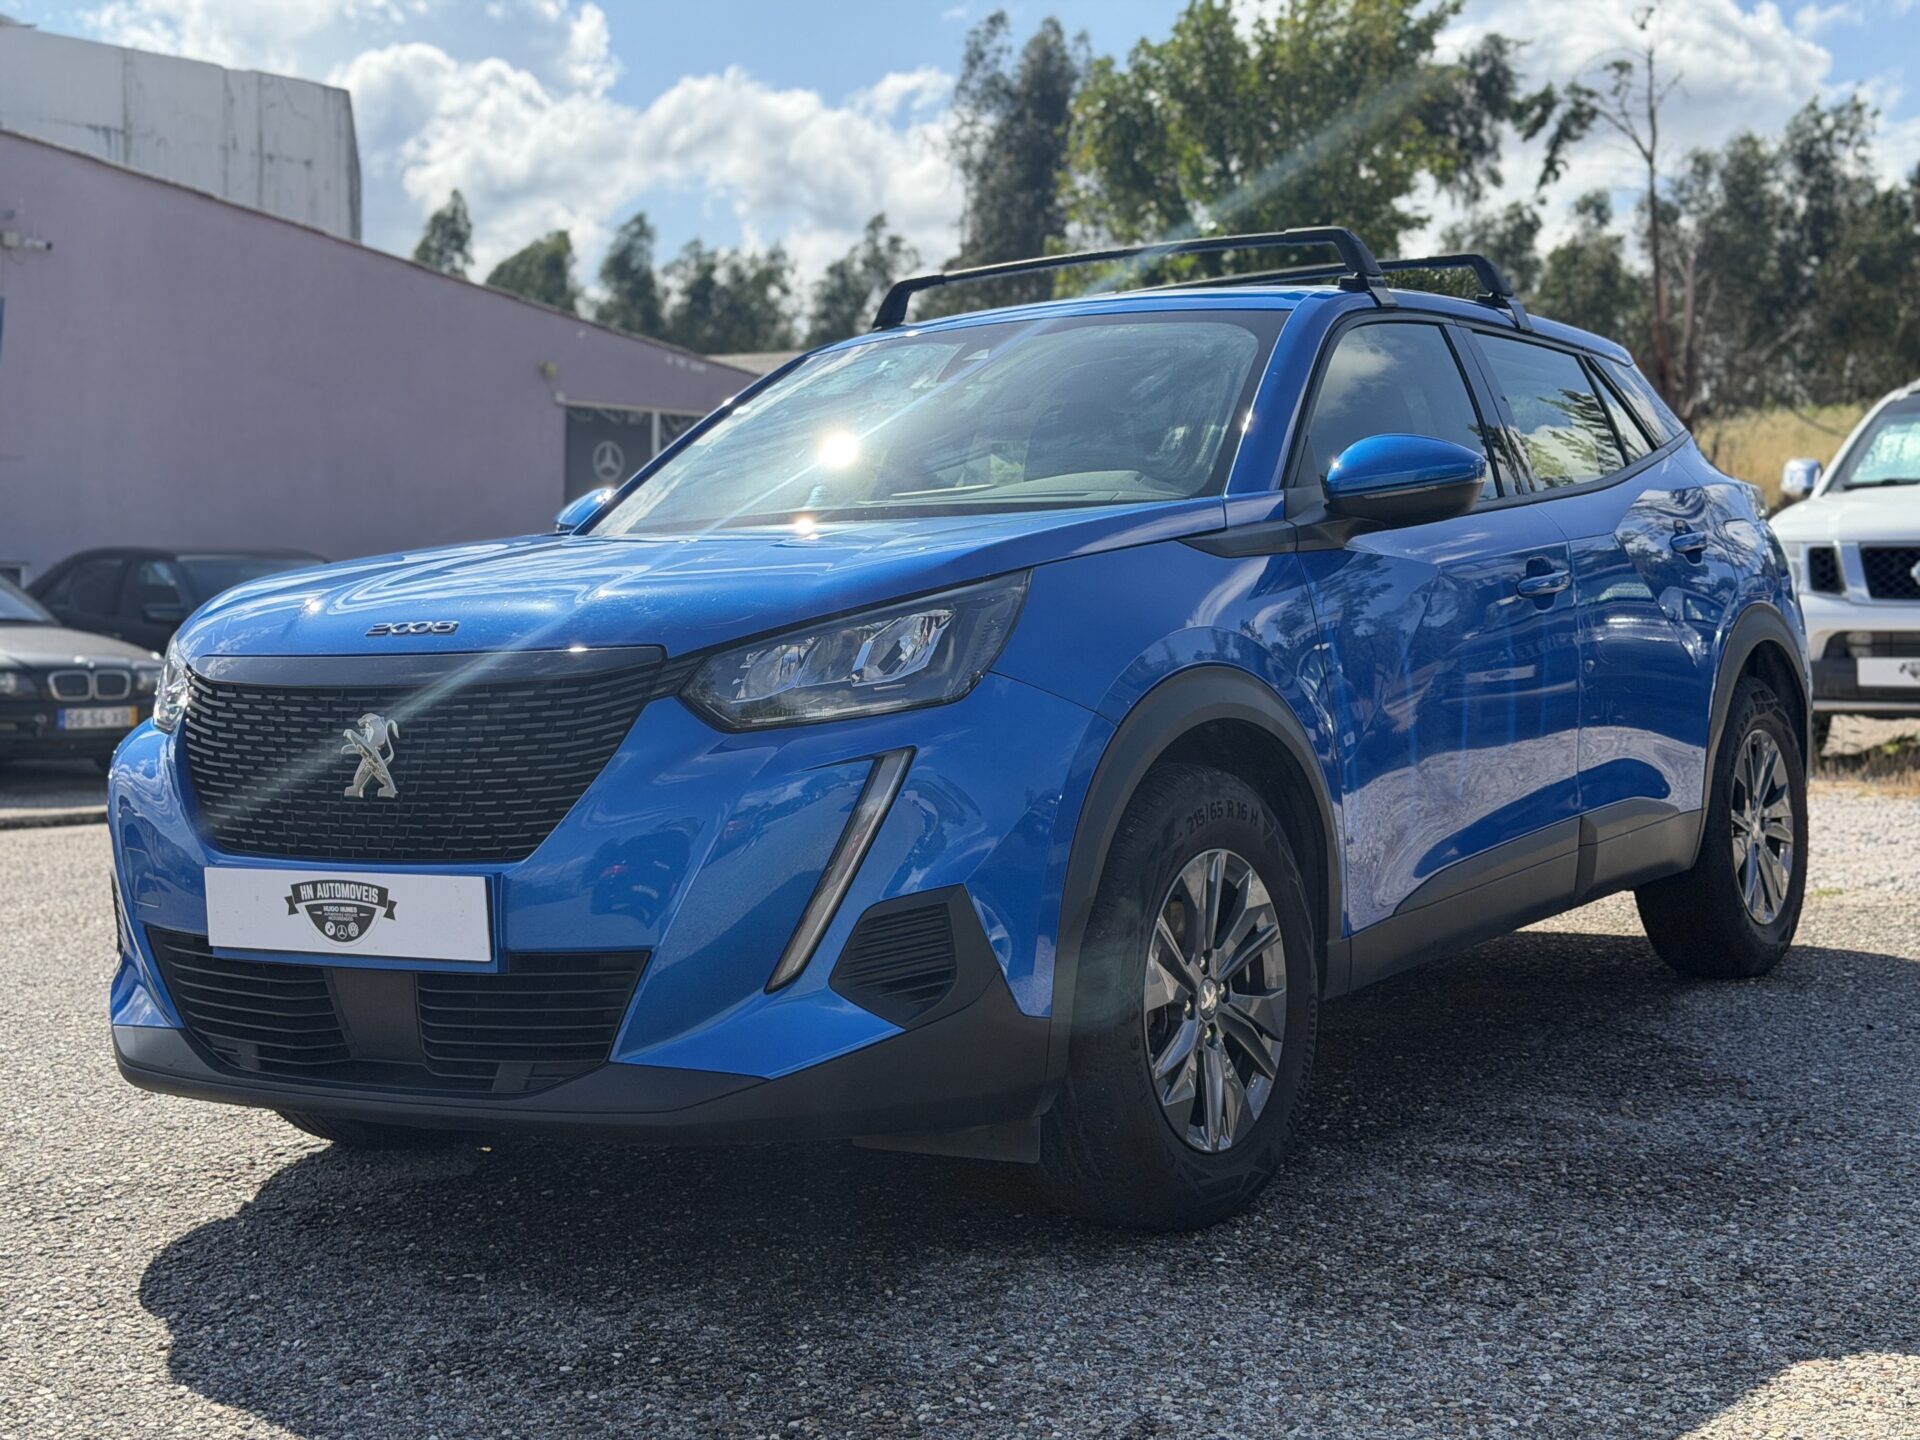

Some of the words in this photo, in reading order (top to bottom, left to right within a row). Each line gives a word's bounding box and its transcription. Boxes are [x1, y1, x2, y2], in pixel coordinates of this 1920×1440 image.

[365, 620, 460, 636] 2008
[1186, 800, 1223, 835] 215/65
[1250, 807, 1259, 828] H
[300, 884, 314, 900] HN
[317, 882, 378, 903] AUTOMOVEIS
